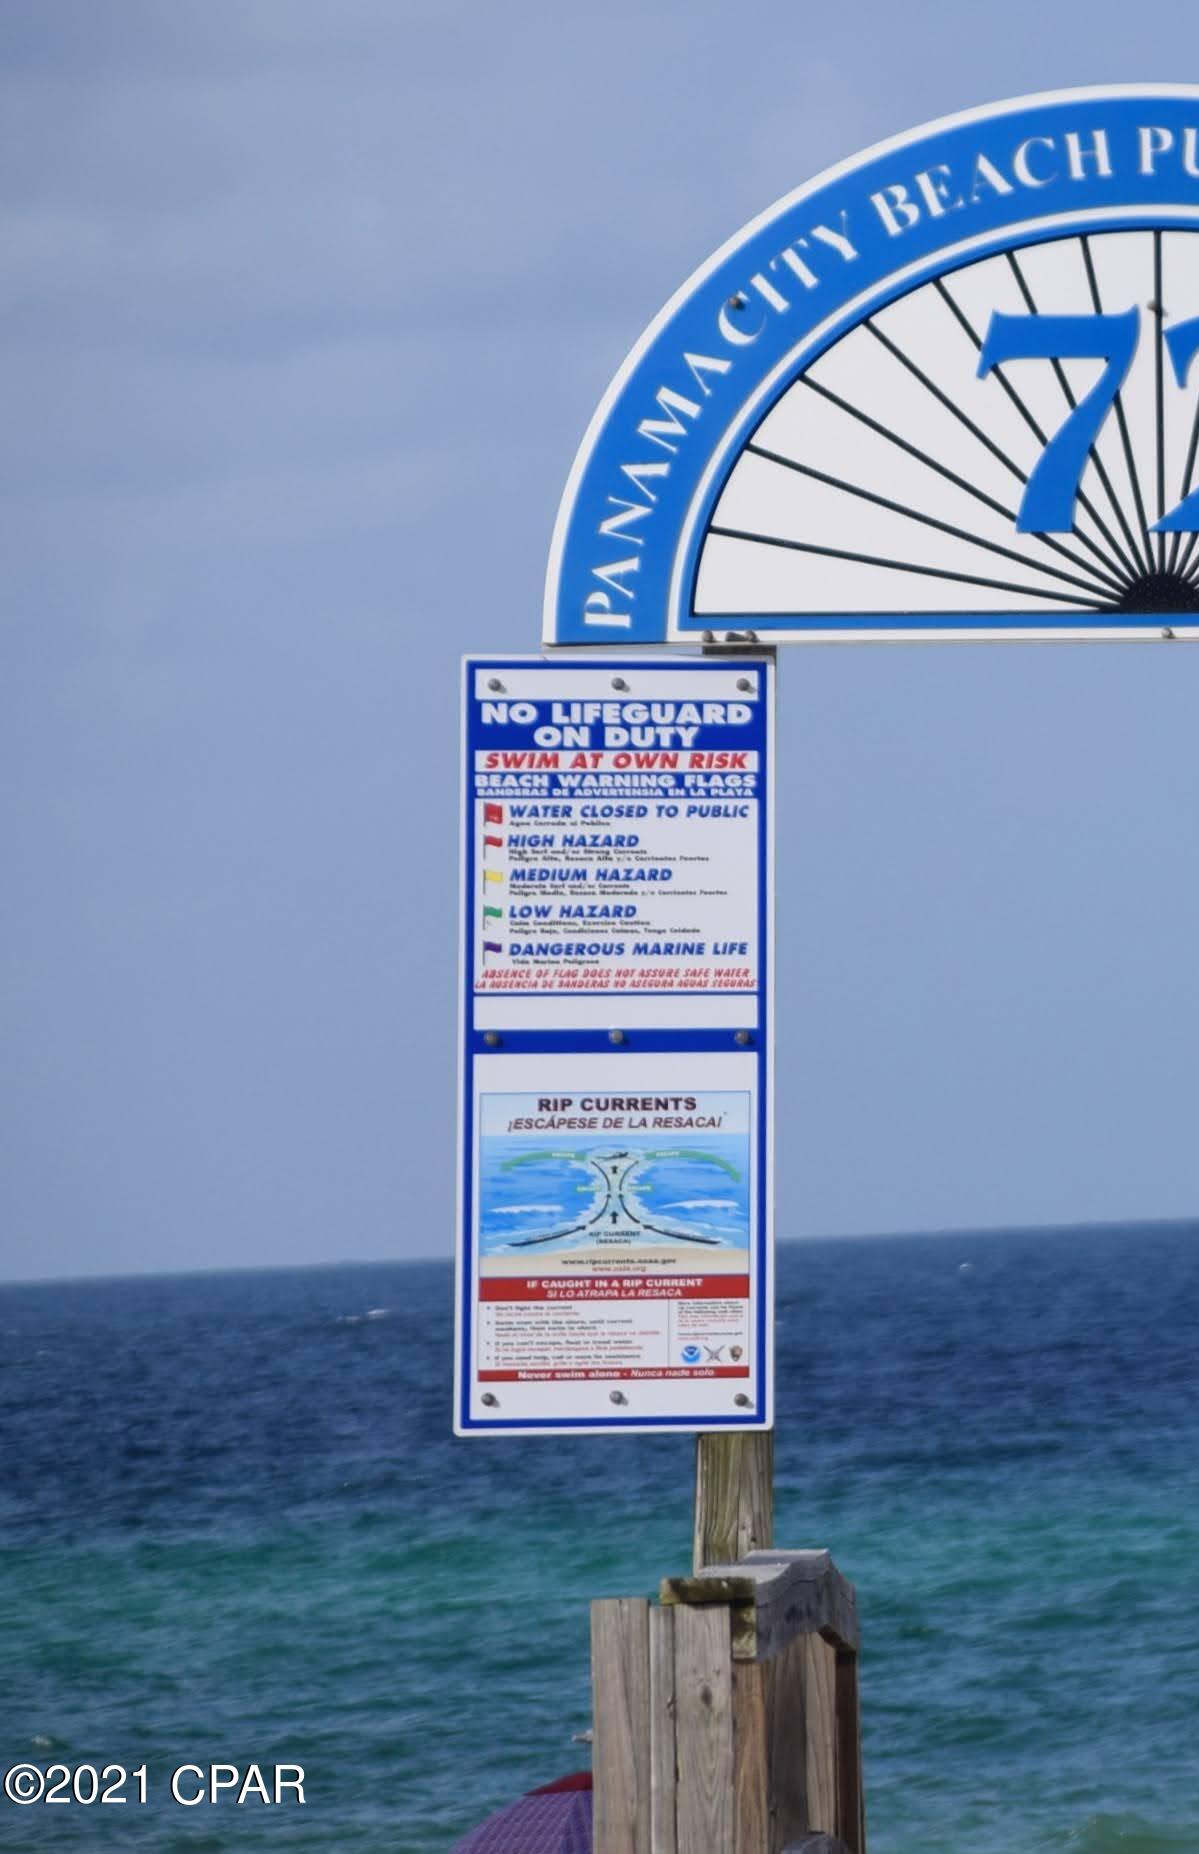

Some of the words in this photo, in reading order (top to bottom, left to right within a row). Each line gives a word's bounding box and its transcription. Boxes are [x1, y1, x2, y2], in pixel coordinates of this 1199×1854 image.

[583, 349, 732, 629] PANAMA
[718, 210, 859, 346] CITY
[869, 129, 1112, 237] BEACH
[481, 703, 537, 725] NO
[552, 703, 752, 725] LIFEGUARD
[534, 727, 590, 748] ON
[604, 727, 699, 748] DUTY
[485, 752, 560, 769] SWIM
[570, 752, 602, 769] AT
[613, 752, 679, 769] OWN
[688, 752, 747, 769] RISK
[475, 775, 548, 787] BEACH
[558, 775, 675, 787] WARNING
[684, 775, 756, 787] FLAGS
[509, 805, 572, 818] WATER
[580, 805, 648, 818] CLOSED
[656, 805, 679, 818] TO
[686, 805, 750, 818] PUBLIC
[508, 835, 556, 847] HIGH
[562, 835, 639, 847] HAZARD
[510, 869, 587, 882] MEDIUM
[596, 869, 672, 882] HAZARD
[509, 905, 552, 918] LOW
[560, 905, 637, 918] HAZARD
[509, 942, 625, 956] DANGEROUS
[632, 942, 705, 956] MARINE
[713, 942, 748, 956] LIFE
[538, 1098, 572, 1112] RIP
[581, 1097, 696, 1111] CURRENTS
[602, 1118, 624, 1128] DE
[628, 1117, 648, 1128] LA
[653, 1116, 722, 1128] RESACA!
[527, 1280, 537, 1288] IF
[542, 1280, 590, 1288] CAUGHT
[595, 1279, 607, 1288] IN
[610, 1279, 620, 1288] A
[622, 1279, 642, 1287] RIP
[646, 1278, 703, 1287] CURRENT
[576, 1289, 619, 1297] ATRAPA
[621, 1289, 635, 1297] LA
[638, 1288, 682, 1297] RESACA
[518, 1371, 550, 1379] Never
[555, 1370, 587, 1379] swim
[589, 1370, 620, 1378] alone
[665, 1369, 690, 1377] nade
[693, 1368, 715, 1376] solo
